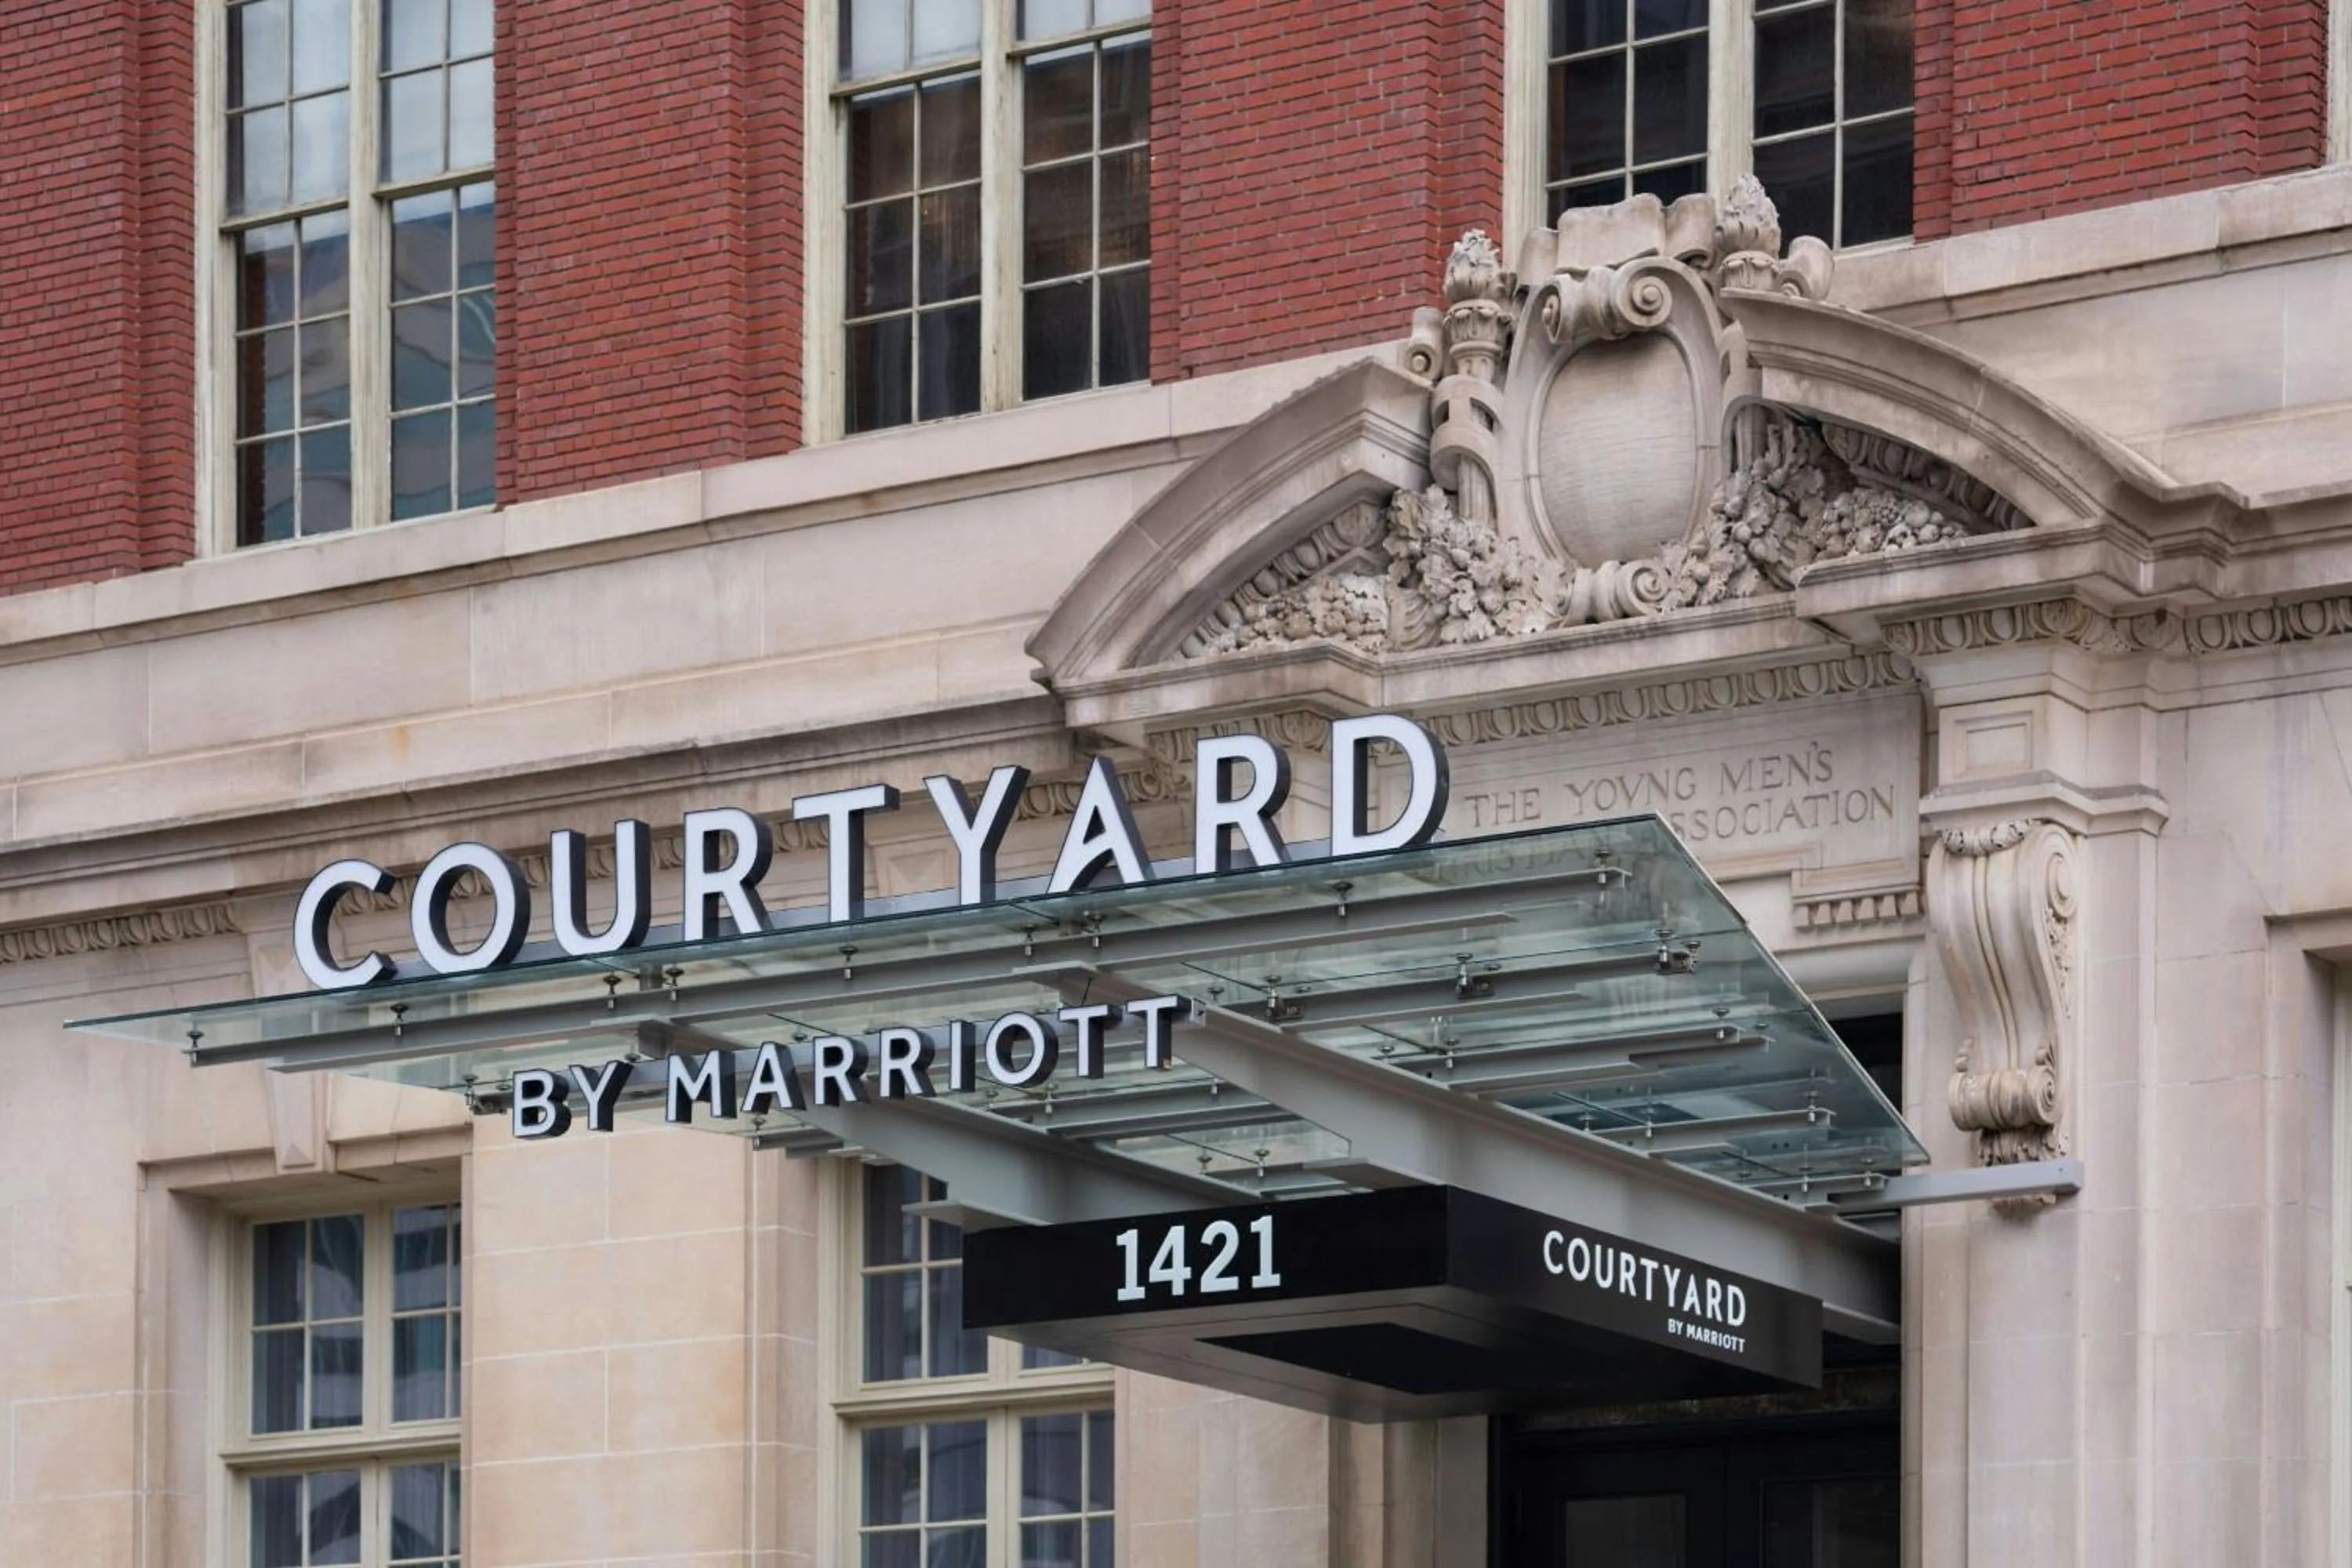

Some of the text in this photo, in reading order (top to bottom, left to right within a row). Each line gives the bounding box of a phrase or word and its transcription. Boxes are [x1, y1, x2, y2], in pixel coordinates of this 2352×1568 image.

[1465, 787, 1541, 828] THE
[1719, 741, 1835, 796] MEN'S
[292, 714, 1449, 991] COURTYARD
[512, 994, 1192, 1140] BY MARRIOTT
[1116, 1214, 1281, 1302] 1421
[1543, 1229, 1747, 1327] COURTYARD
[1668, 1318, 1746, 1353] BY MARRIOTT
